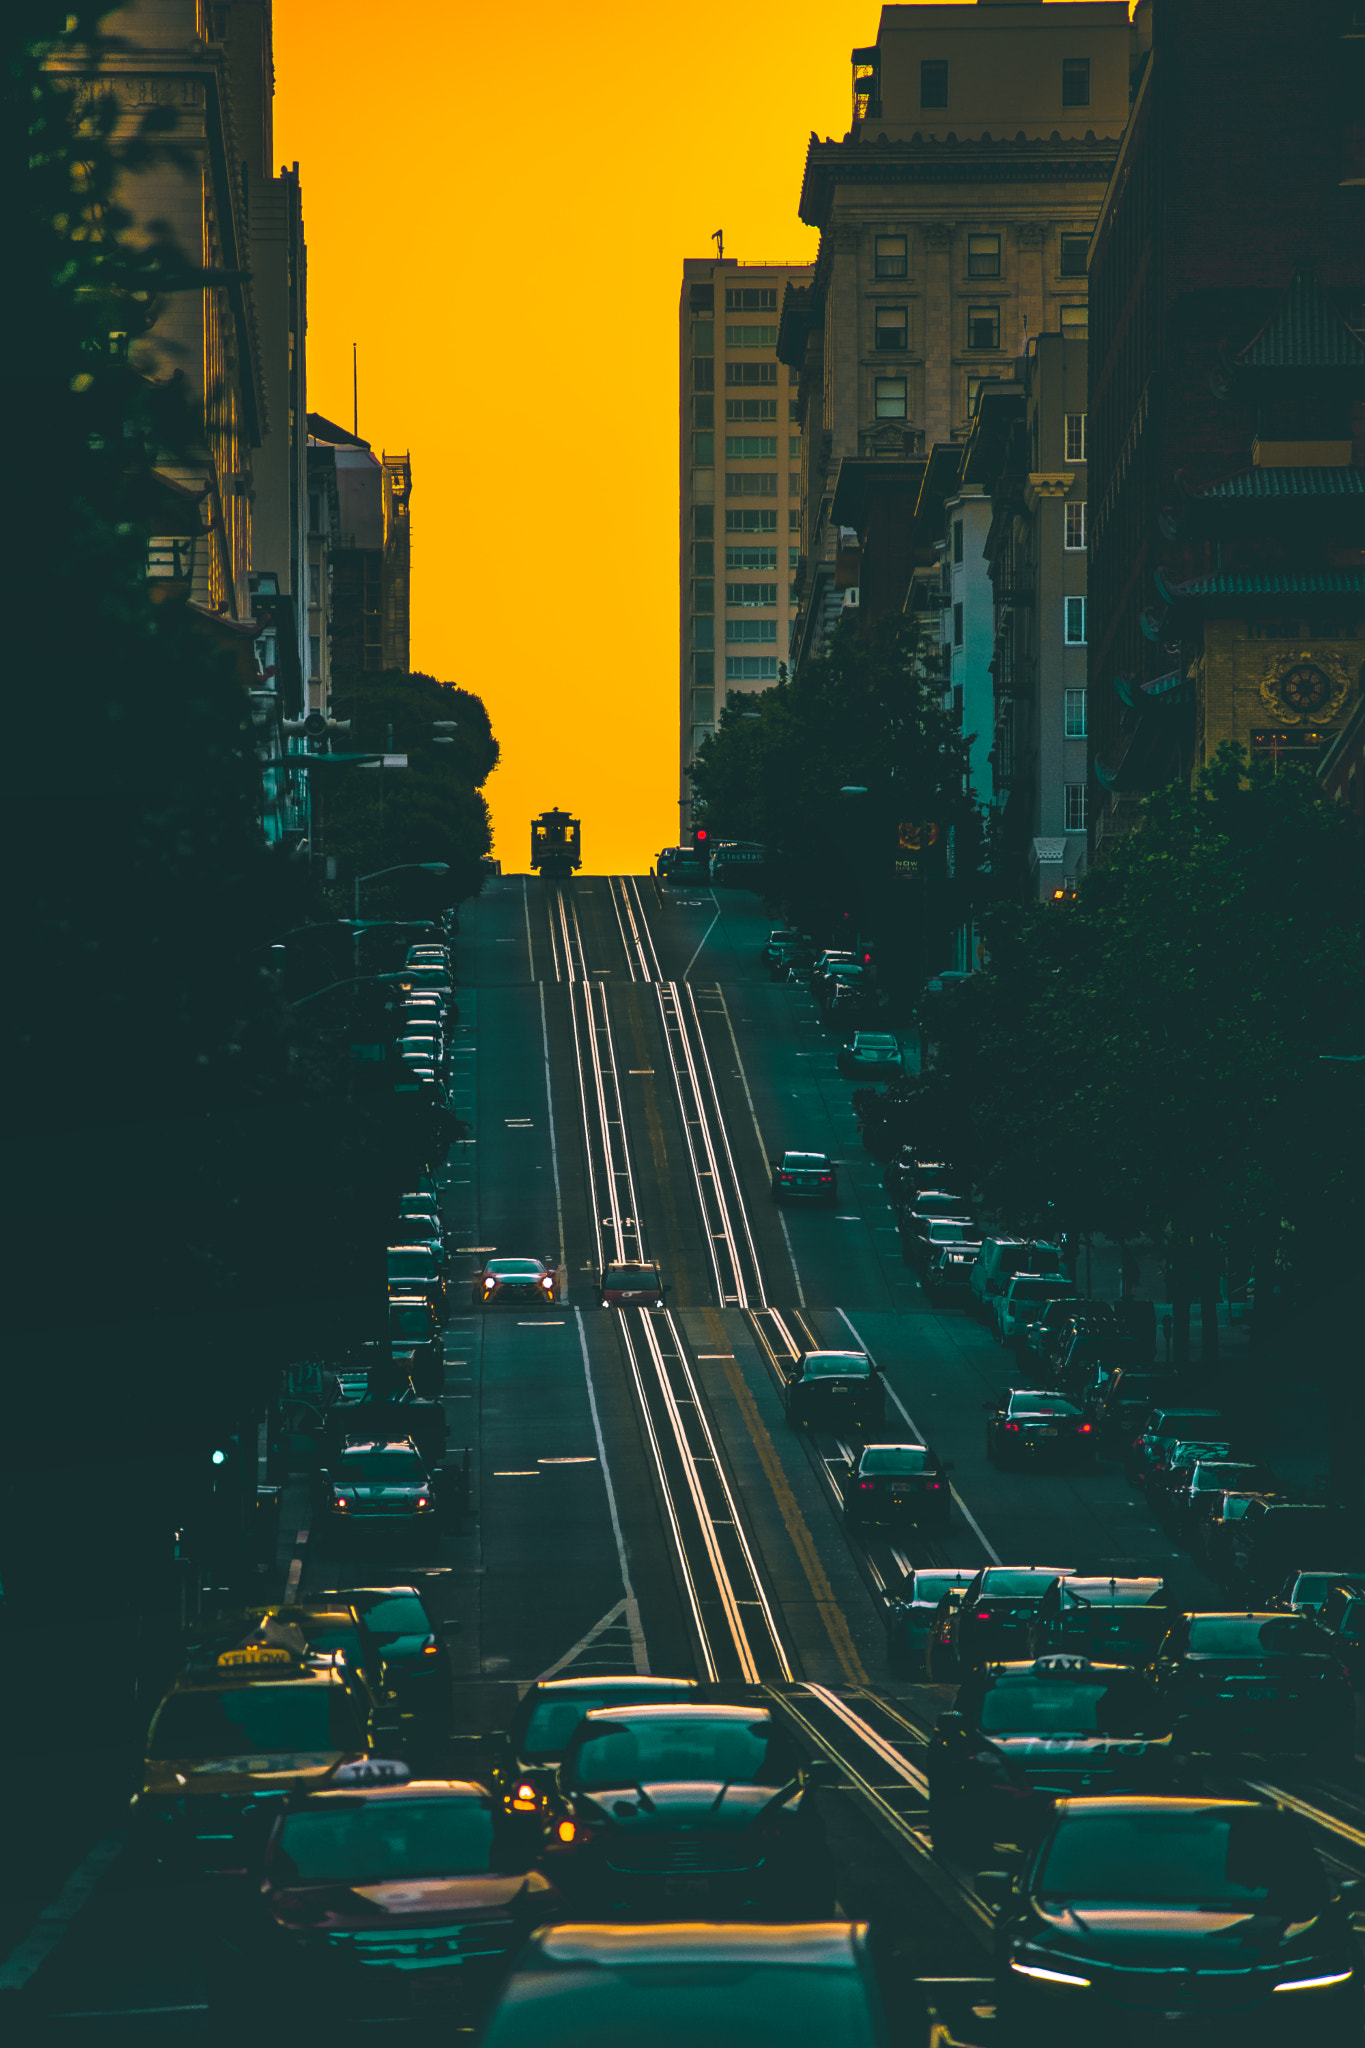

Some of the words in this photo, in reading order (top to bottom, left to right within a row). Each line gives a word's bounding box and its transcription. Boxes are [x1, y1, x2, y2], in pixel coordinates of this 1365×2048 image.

[223, 1652, 286, 1666] YELLOW
[1042, 1659, 1085, 1671] TAXI
[352, 1765, 396, 1780] TAXI
